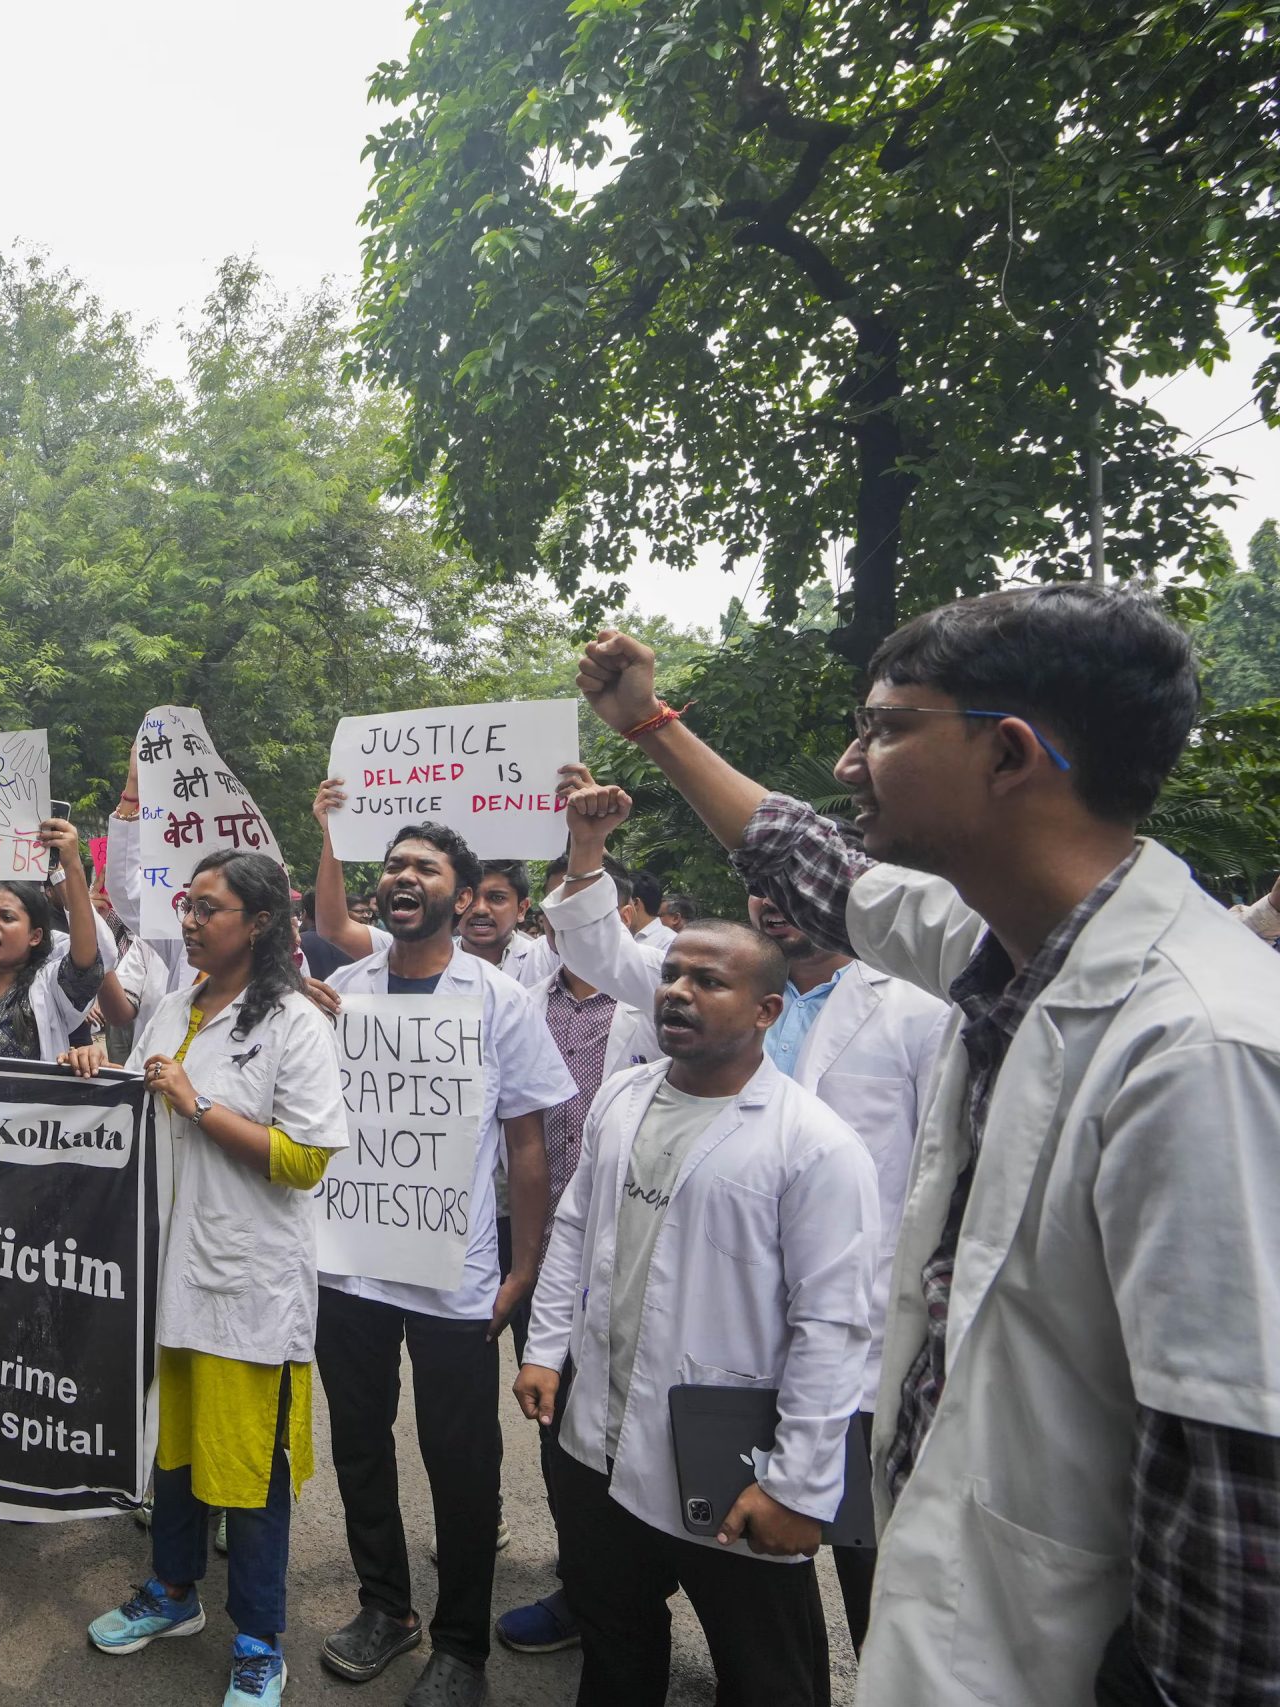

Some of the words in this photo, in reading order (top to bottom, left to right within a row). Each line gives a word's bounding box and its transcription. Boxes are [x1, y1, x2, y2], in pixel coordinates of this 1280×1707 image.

[138, 735, 173, 764] बेटी
[361, 724, 506, 755] JUSTICE
[173, 766, 208, 801] बेटी
[364, 762, 464, 788] DELAYED
[498, 762, 522, 783] IS
[142, 806, 164, 820] But
[351, 796, 442, 816] JUSTICE
[472, 794, 568, 813] DENIED
[163, 811, 205, 848] बेटी
[12, 828, 49, 874] চাই
[144, 867, 173, 888] पर
[357, 1128, 447, 1172] NOT
